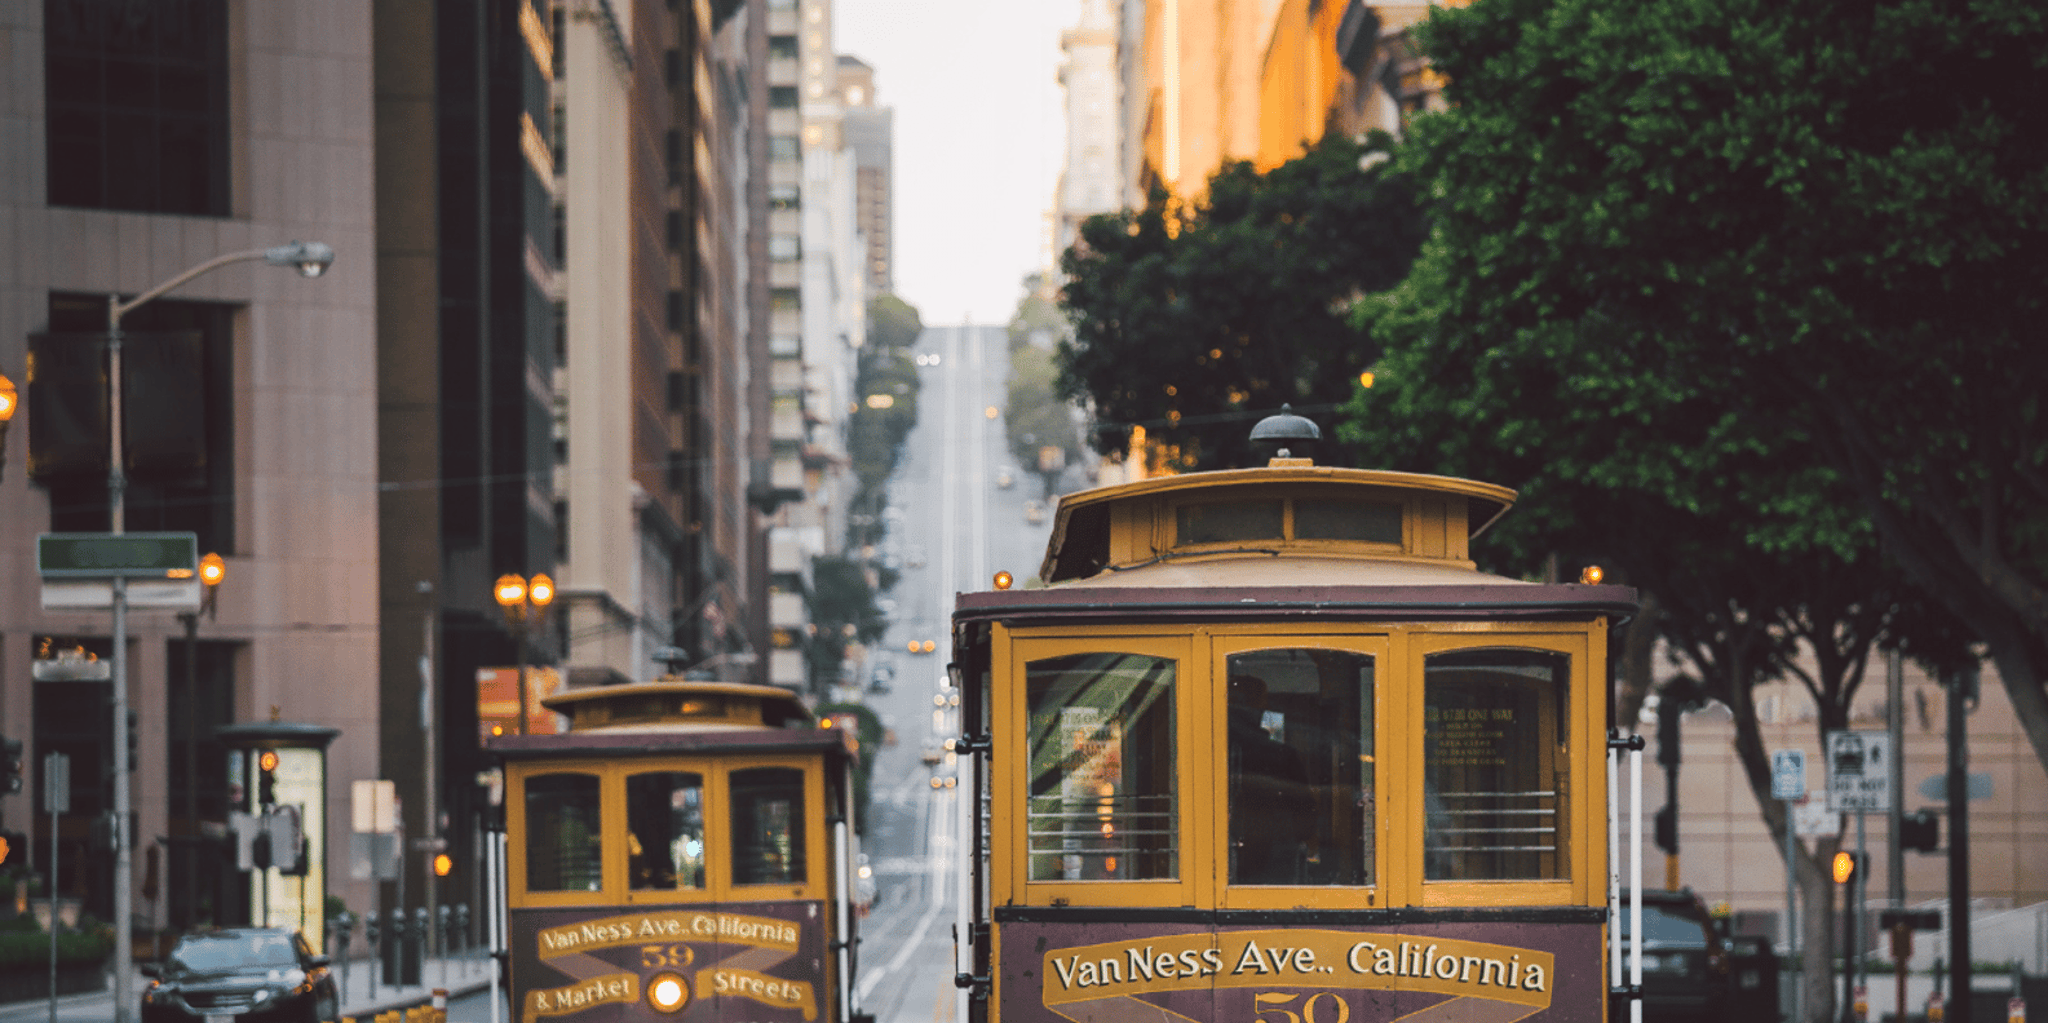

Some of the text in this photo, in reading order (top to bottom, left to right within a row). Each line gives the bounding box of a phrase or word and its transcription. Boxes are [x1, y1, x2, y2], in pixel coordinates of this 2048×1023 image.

[543, 930, 580, 950] Van
[581, 922, 633, 945] Ness
[691, 914, 797, 943] California
[641, 944, 694, 968] 59
[1051, 954, 1122, 990] Van
[1126, 946, 1223, 983] Ness
[1348, 941, 1546, 992] California
[536, 978, 630, 1011] & Market
[714, 971, 802, 1002] Streets
